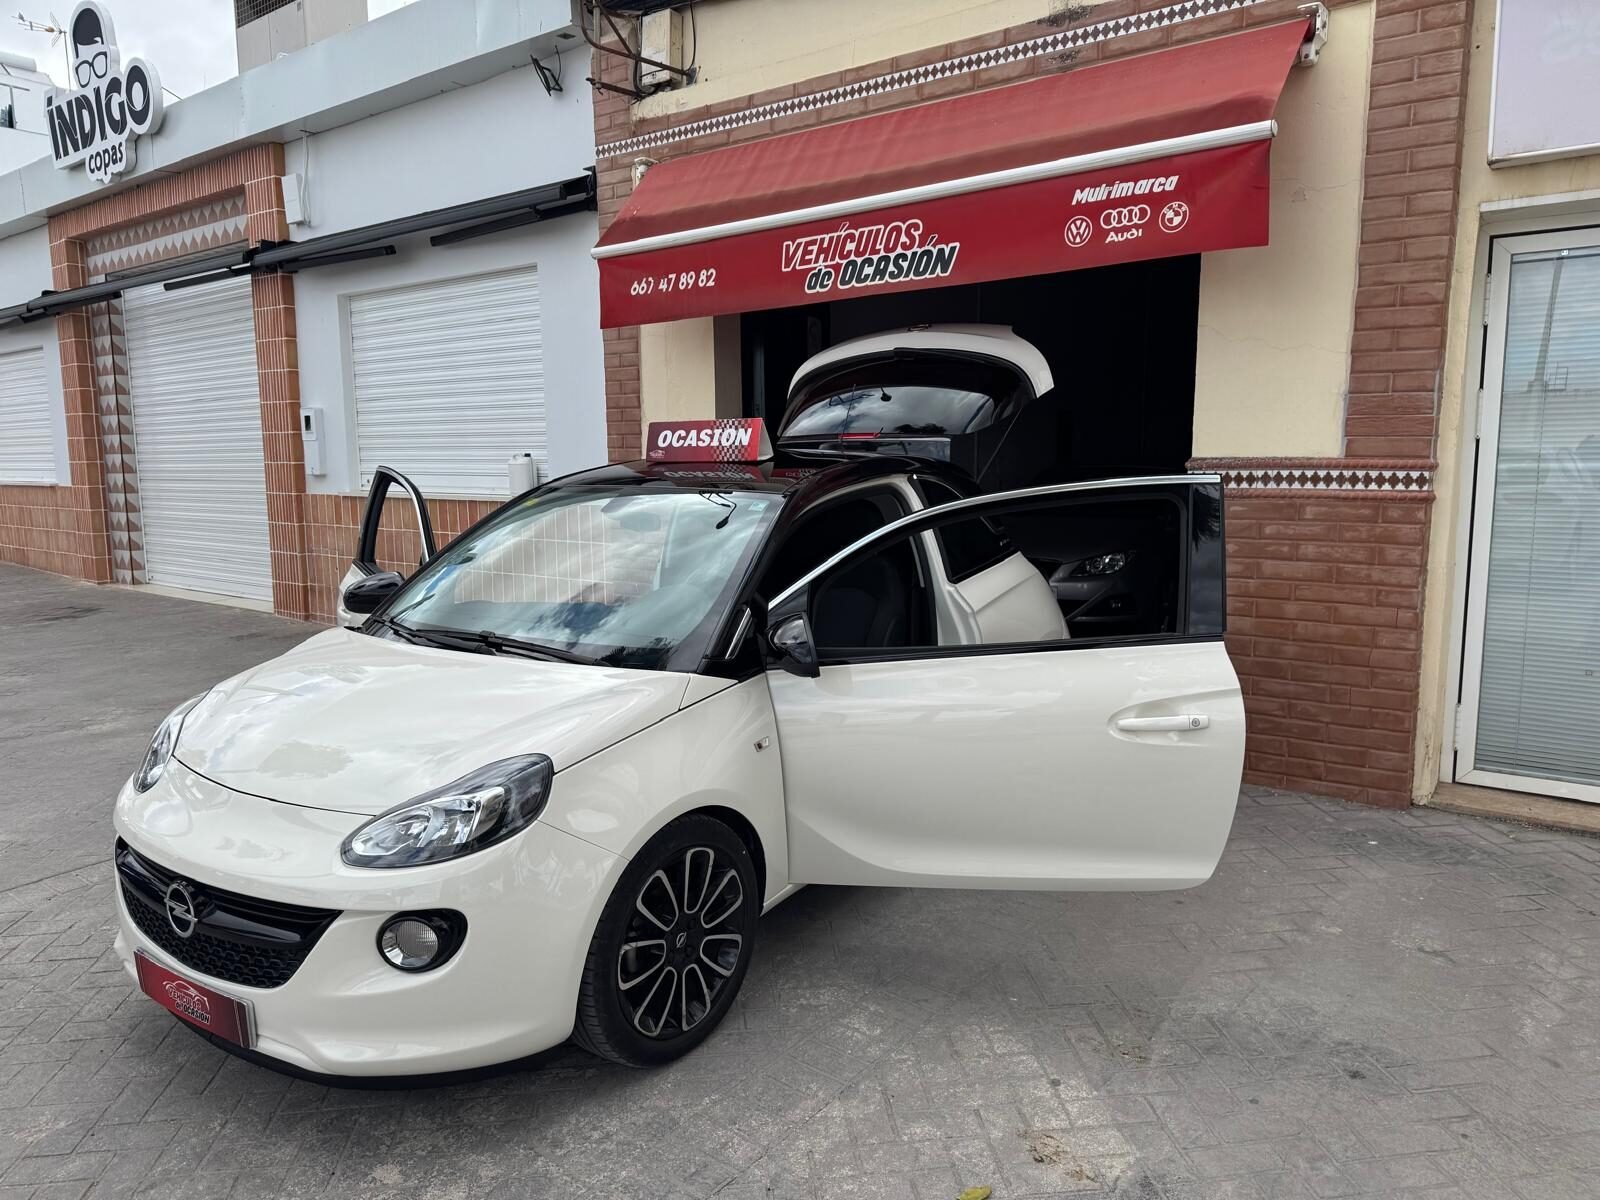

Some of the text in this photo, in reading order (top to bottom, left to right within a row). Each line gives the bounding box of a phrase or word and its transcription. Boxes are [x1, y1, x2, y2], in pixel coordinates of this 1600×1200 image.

[47, 65, 151, 161] ÍNDIGO
[89, 142, 124, 176] copas
[782, 219, 923, 272] VEHÍCULOS
[1104, 228, 1143, 244] Audi
[658, 273, 677, 292] 47
[679, 271, 696, 290] 89
[698, 268, 717, 288] 82
[805, 234, 960, 294] de OCASIÓN
